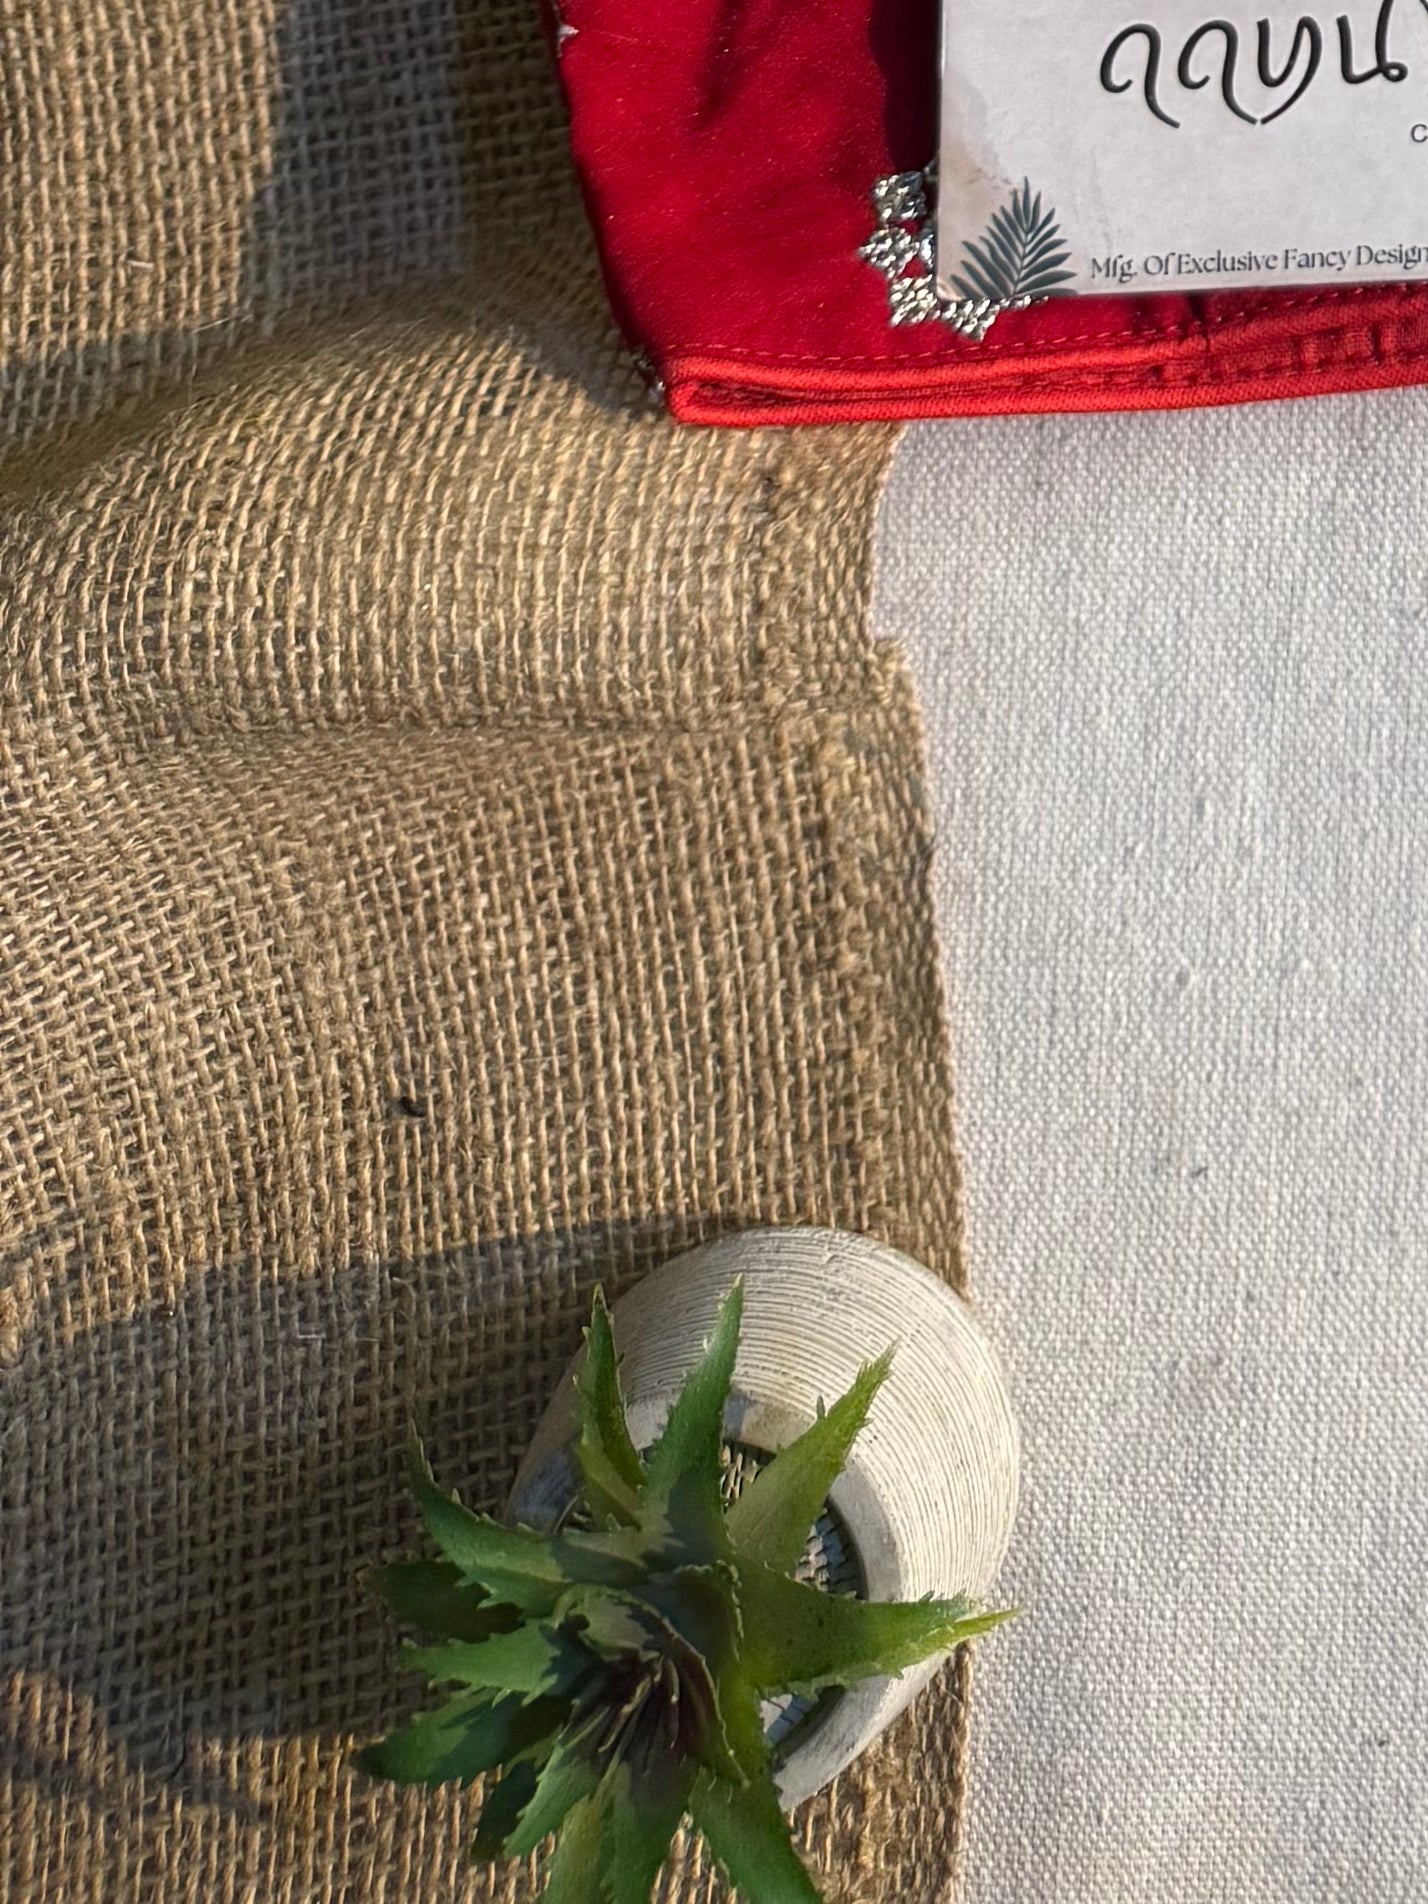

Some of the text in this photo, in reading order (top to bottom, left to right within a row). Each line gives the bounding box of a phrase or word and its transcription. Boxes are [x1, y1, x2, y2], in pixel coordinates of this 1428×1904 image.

[1090, 254, 1138, 283] Mfg.
[1143, 252, 1176, 276] Of
[1177, 248, 1279, 275] Exclusive
[1283, 248, 1352, 271] Fancy
